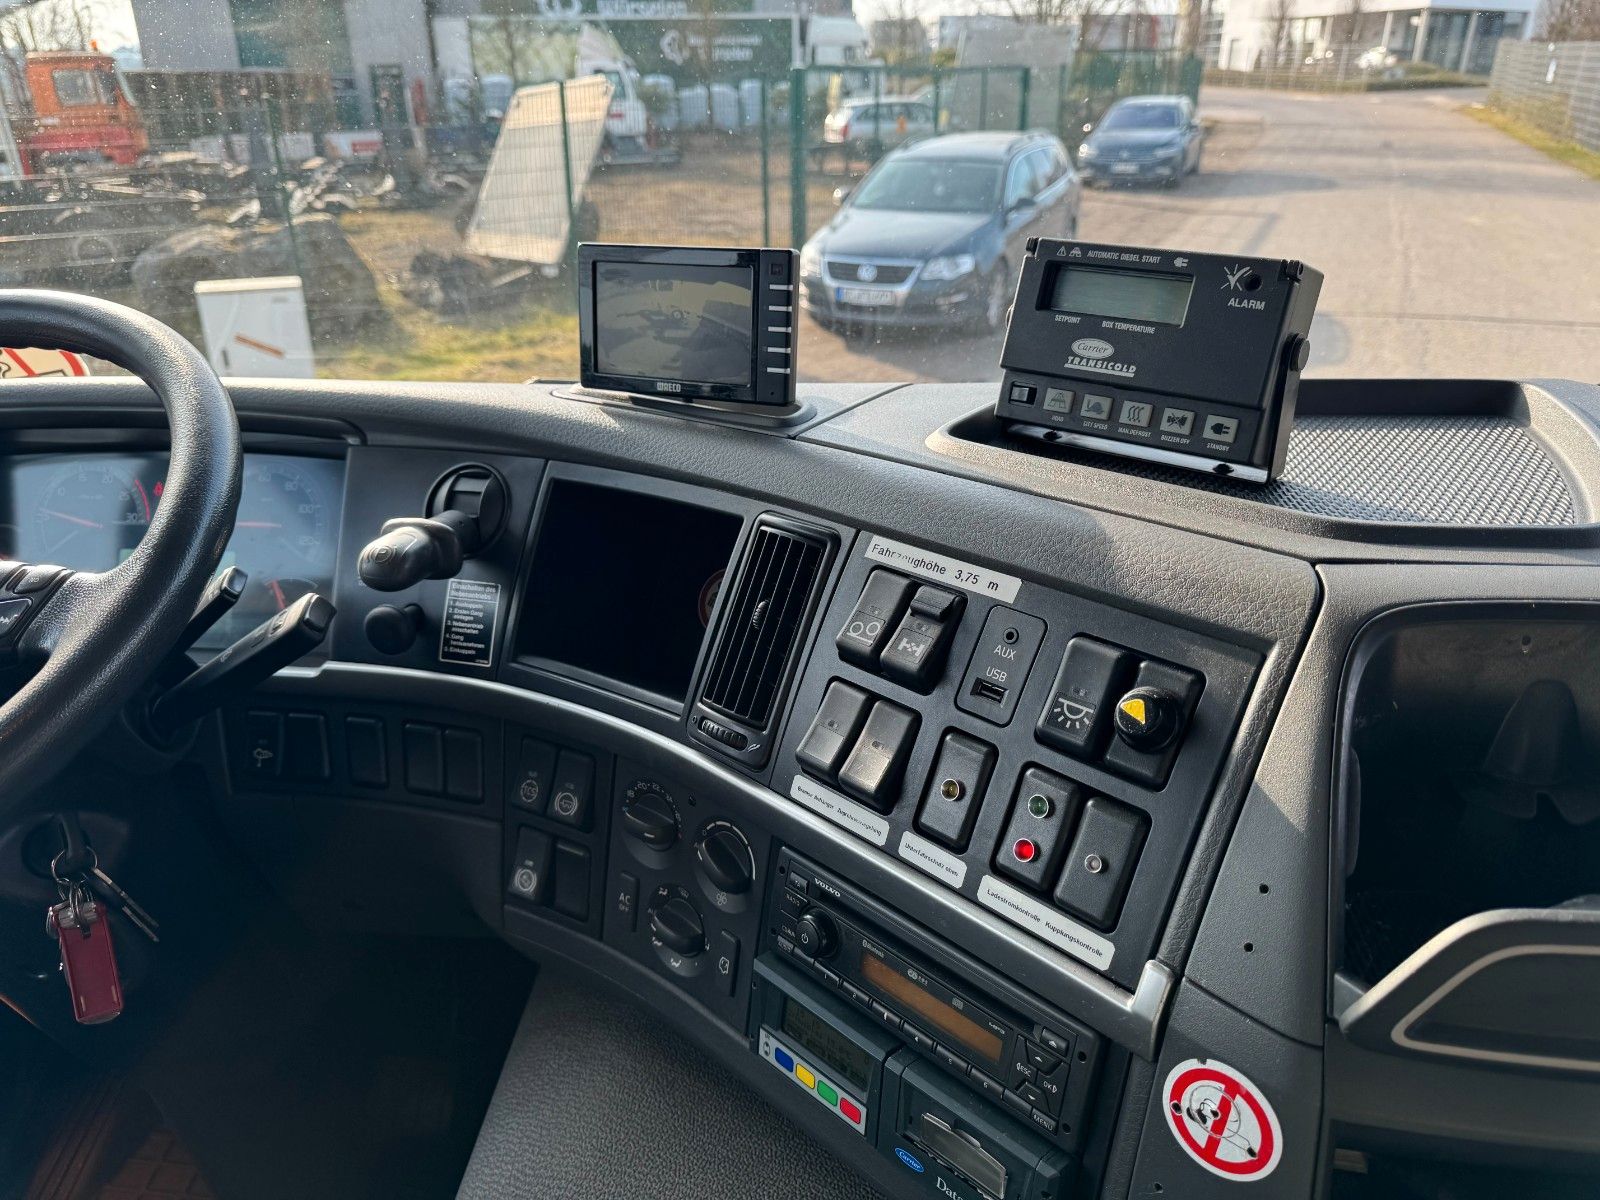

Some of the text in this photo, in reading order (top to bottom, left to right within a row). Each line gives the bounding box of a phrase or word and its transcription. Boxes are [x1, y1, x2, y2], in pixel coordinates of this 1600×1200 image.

[1087, 250, 1161, 264] AUTOMATIC DIESEL START
[1227, 297, 1266, 311] ALARM
[1054, 314, 1082, 324] SETPOINT
[1101, 320, 1156, 335] BOX TEMPERATURE
[1077, 341, 1108, 355] Carrier
[1067, 355, 1137, 373] TRANSICOLD
[871, 543, 999, 592] Fahrughöhe 3,75 m
[993, 644, 1017, 661] AUX
[986, 666, 1007, 682] USB
[814, 877, 841, 898] VOLVO
[619, 892, 631, 904] AC
[986, 887, 1103, 958] Ladestromkontrolle Kupplungskontrolle
[1033, 1114, 1054, 1131] MENU
[899, 1151, 921, 1170] Carrier
